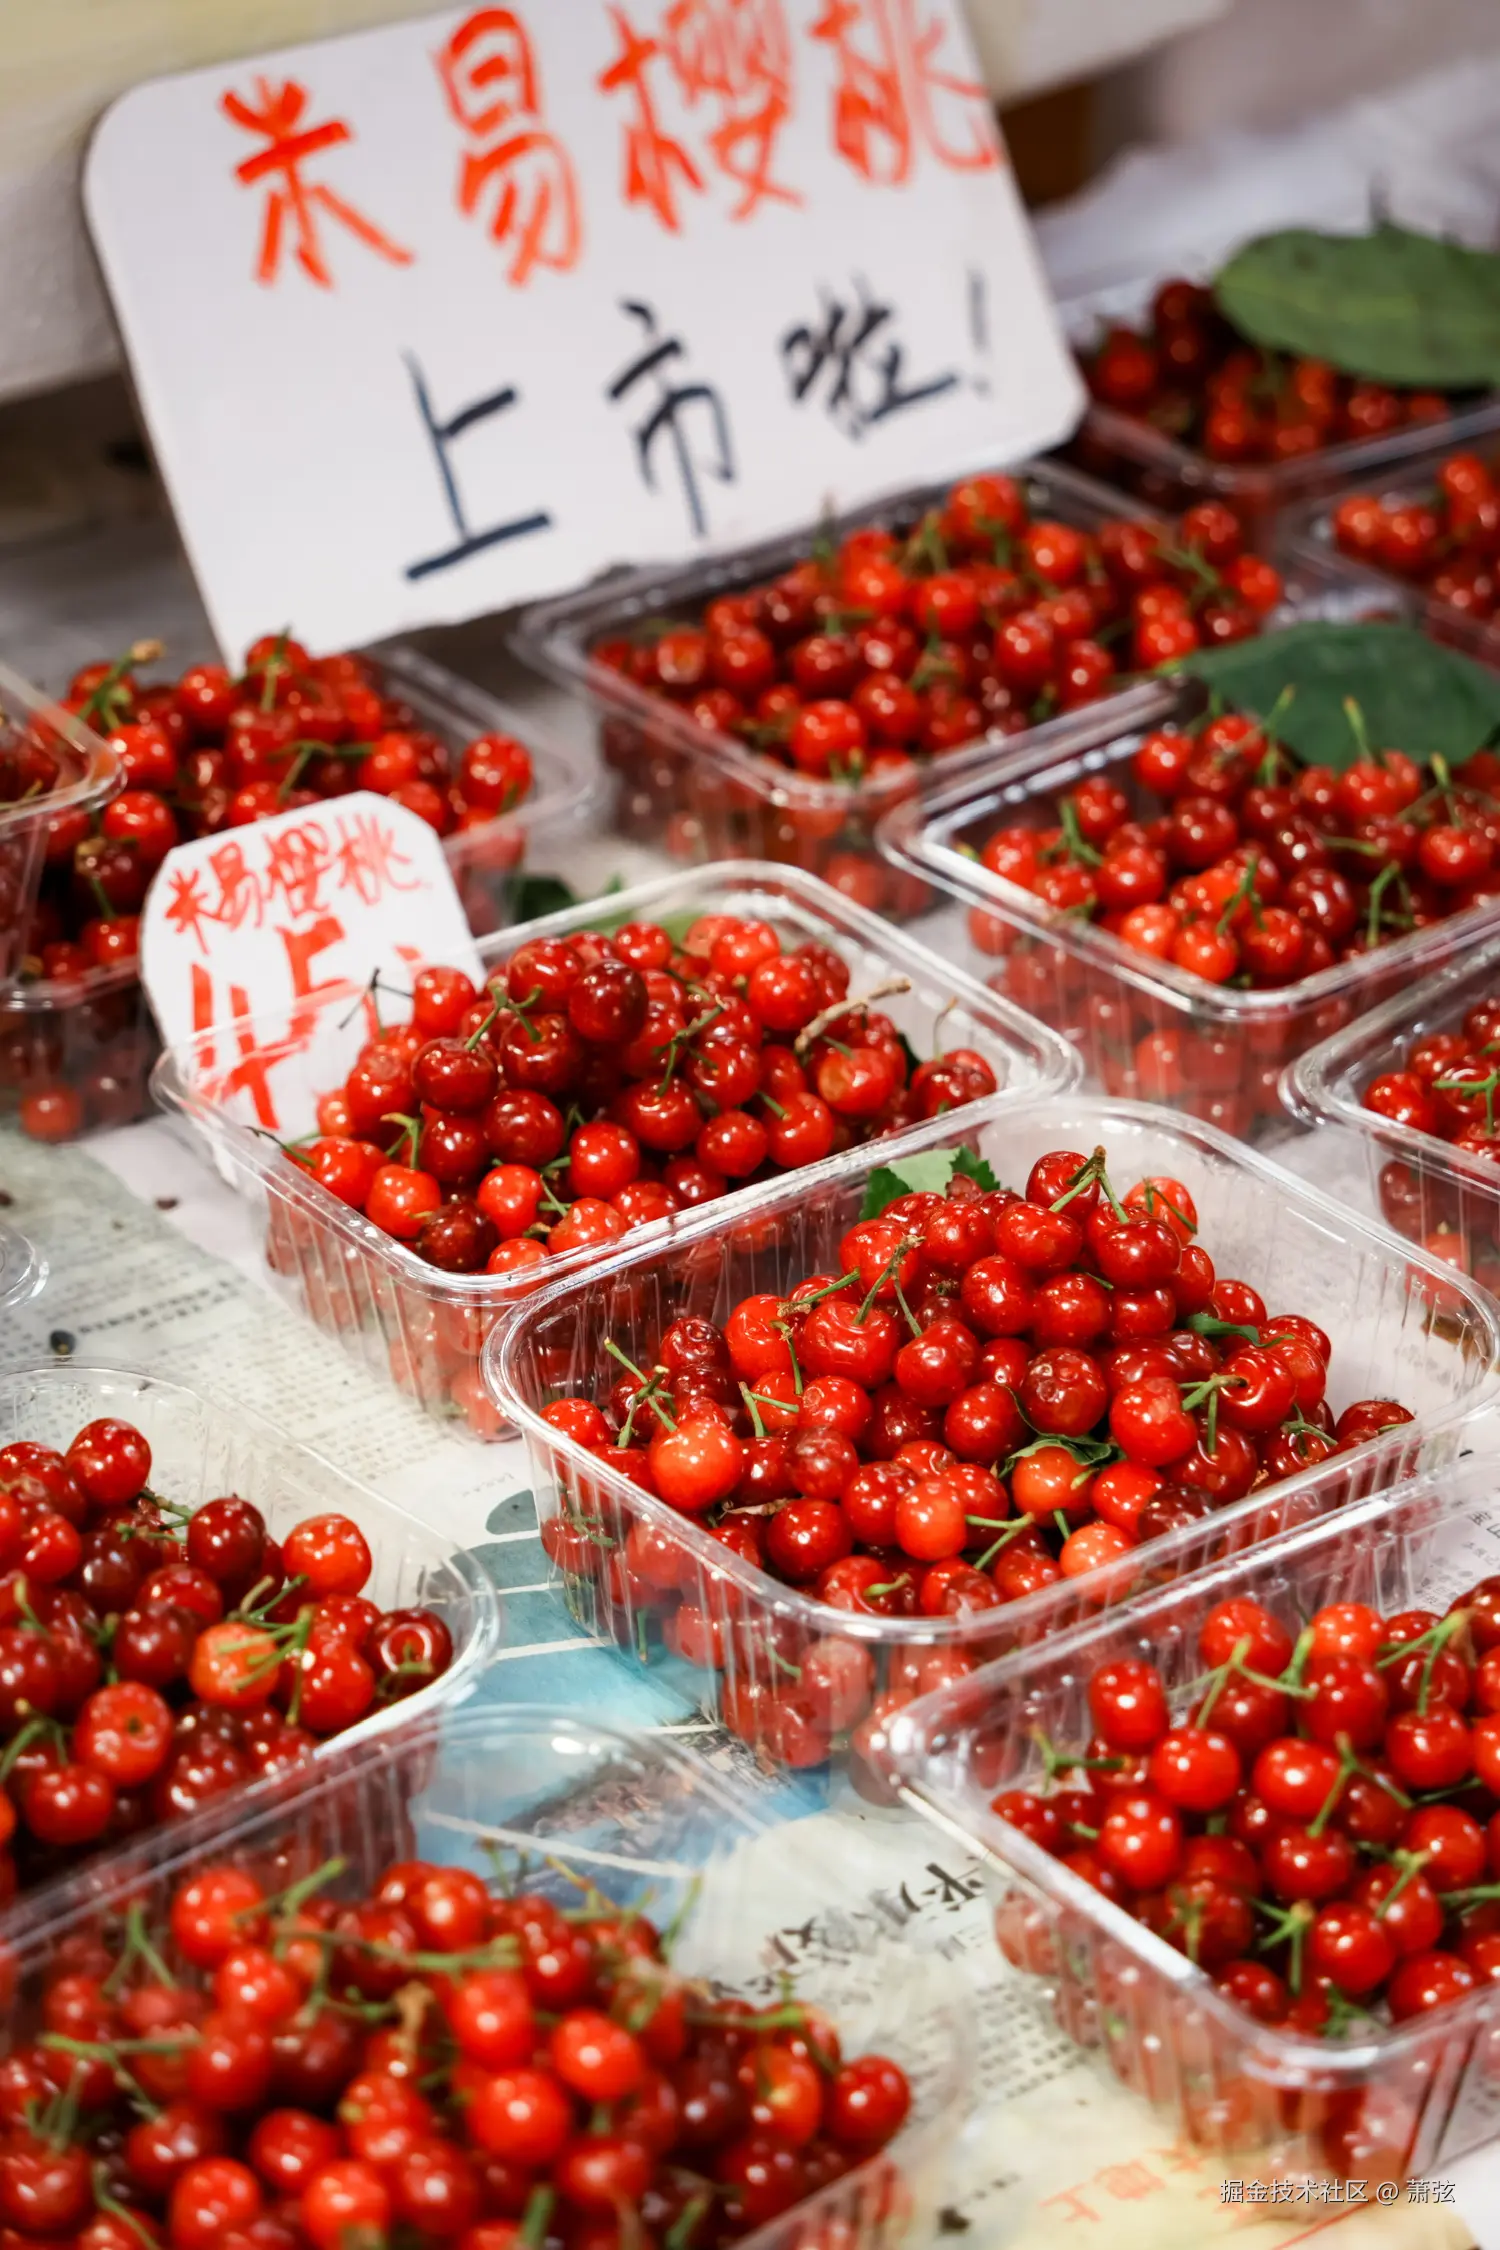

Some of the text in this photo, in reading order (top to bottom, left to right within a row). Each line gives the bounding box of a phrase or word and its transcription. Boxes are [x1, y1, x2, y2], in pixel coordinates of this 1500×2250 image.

[219, 0, 1002, 289] 米易樱桃
[164, 813, 431, 955] 米易樱桃
